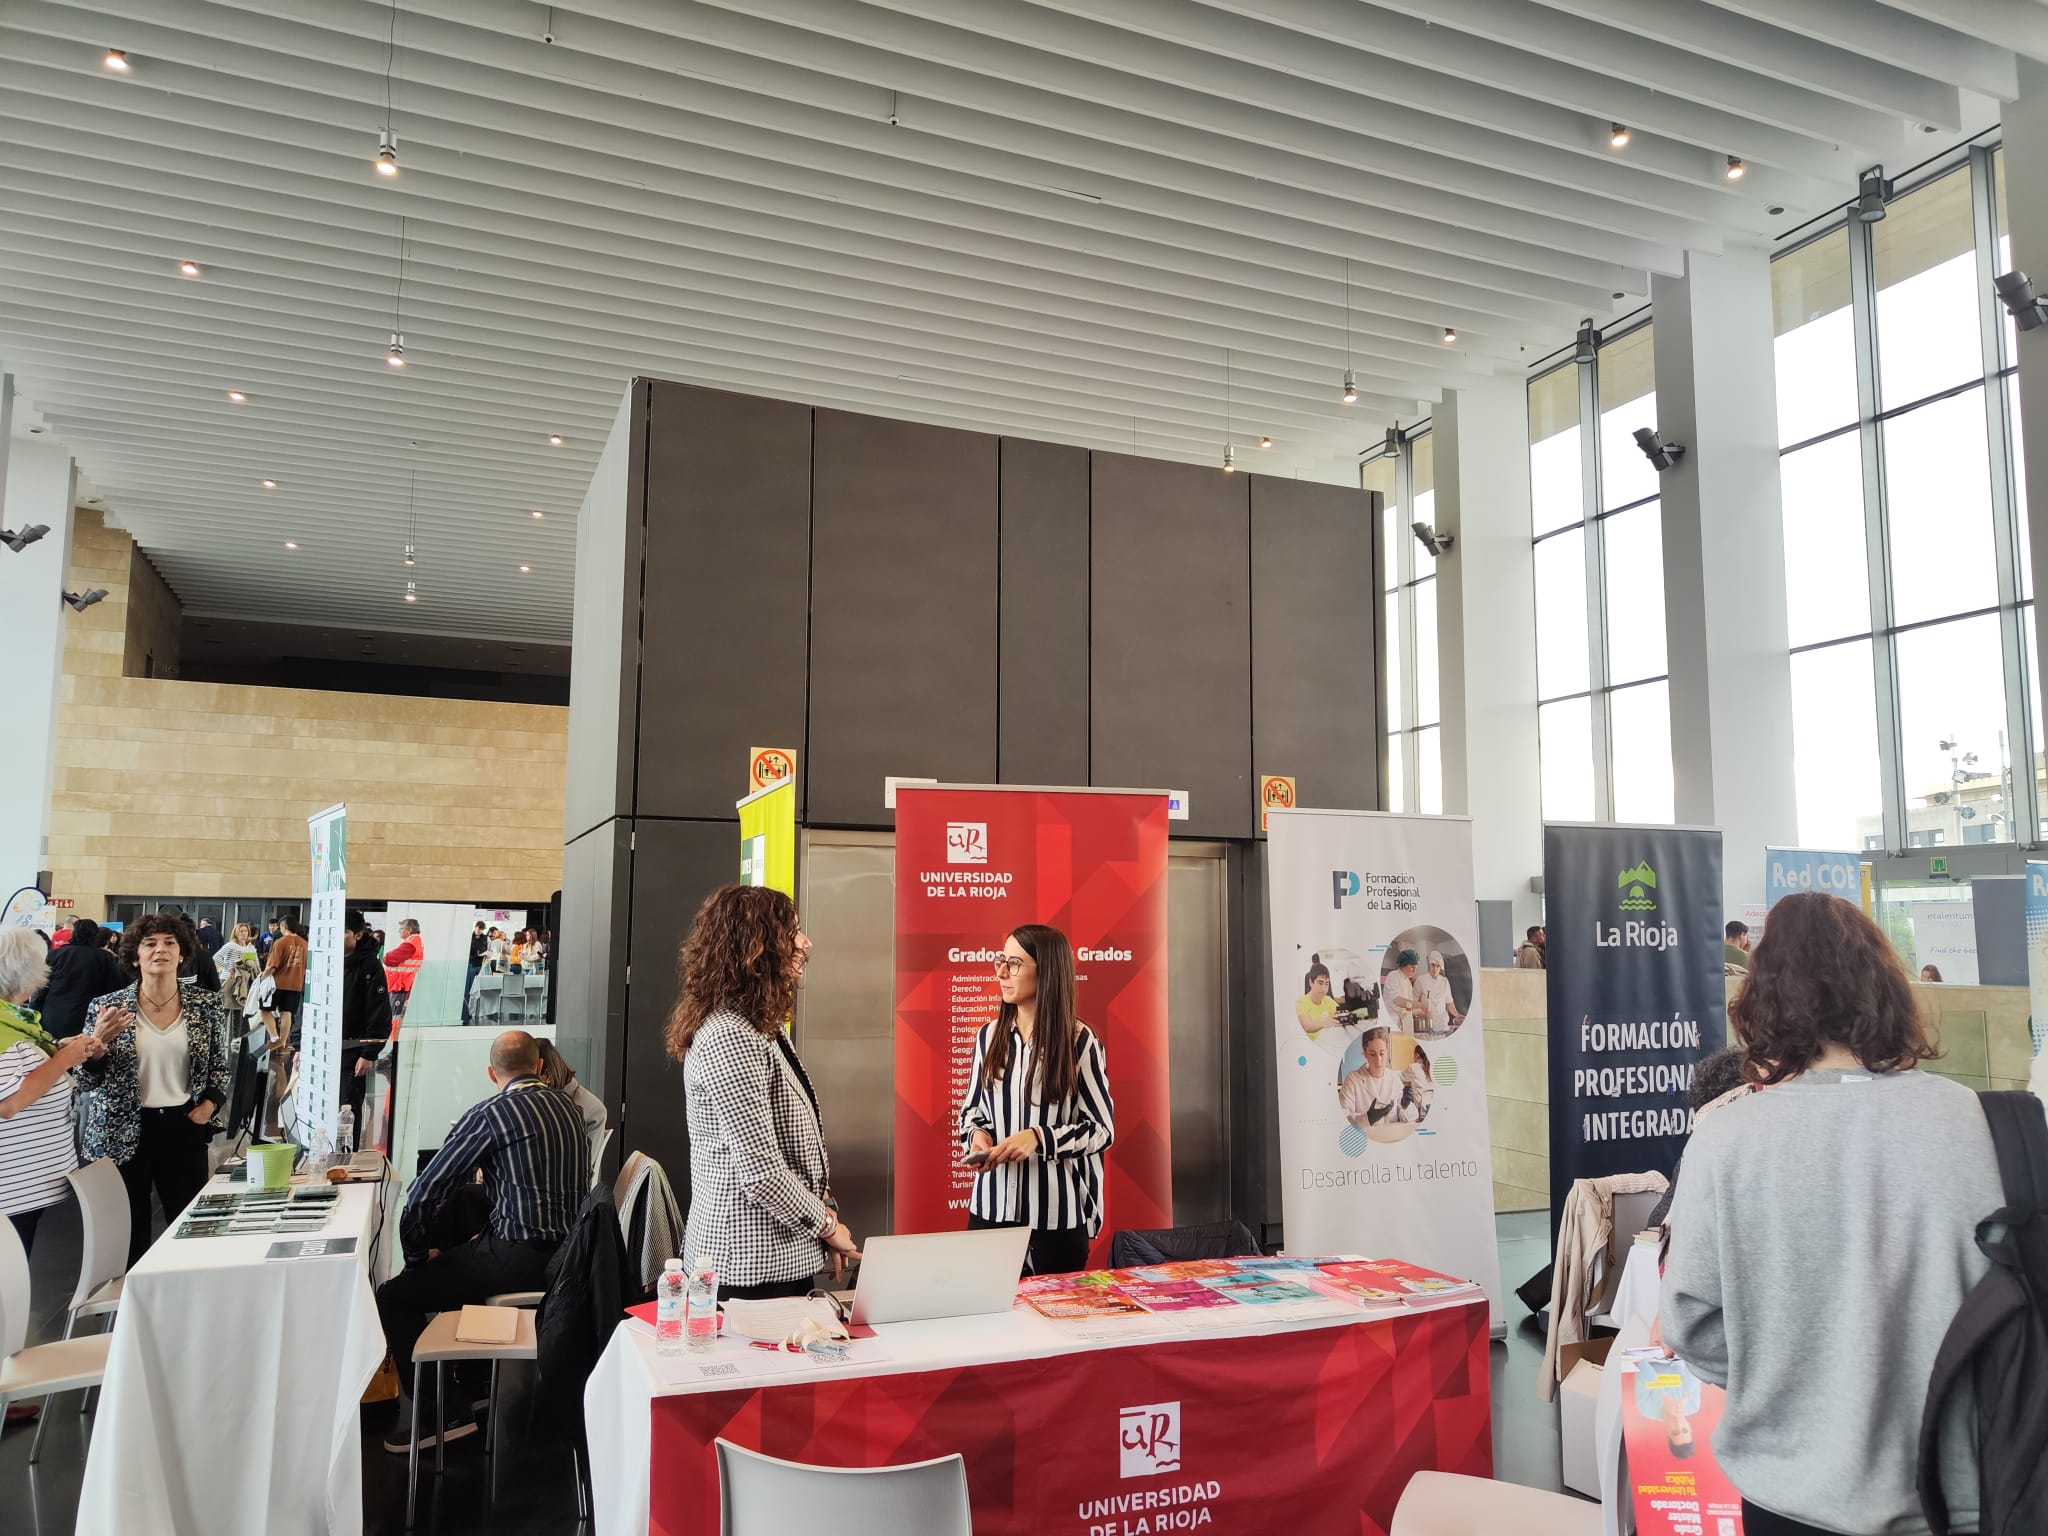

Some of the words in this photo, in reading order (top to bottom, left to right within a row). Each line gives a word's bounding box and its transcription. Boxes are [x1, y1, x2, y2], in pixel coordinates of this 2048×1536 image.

[920, 872, 1013, 883] UNIVERSIDAD
[1365, 873, 1415, 884] Formación
[1772, 863, 1811, 889] Red
[1817, 864, 1857, 889] COE
[927, 887, 946, 897] DE
[949, 887, 967, 897] LA
[970, 887, 1007, 900] RIOJA
[1366, 886, 1421, 898] Profesional
[1367, 899, 1379, 910] de
[1381, 900, 1392, 910] La
[1393, 900, 1417, 912] Rioja
[1596, 921, 1621, 947] La
[1625, 920, 1678, 951] Rioja
[1077, 946, 1132, 962] Grados
[951, 985, 982, 993] Derecho
[951, 1005, 988, 1013] Educación
[951, 1015, 991, 1023] Enfermería
[1581, 1012, 1698, 1052] FORMACIÓN
[1574, 1064, 1696, 1098] PROFESIONA
[1584, 1108, 1696, 1141] INTEGRADA
[1301, 1163, 1391, 1190] Desarrolla
[1396, 1164, 1412, 1182] tu
[1417, 1160, 1478, 1181] talento
[951, 1181, 974, 1189] Turism
[1637, 1485, 1686, 1496] Universidad
[1078, 1480, 1221, 1520] UNIVERSIDAD
[1650, 1500, 1700, 1512] Doctorado
[1090, 1522, 1117, 1536] DE
[1123, 1517, 1150, 1536] LA
[1155, 1507, 1212, 1532] RIOJA
[1673, 1524, 1703, 1536] Grado
